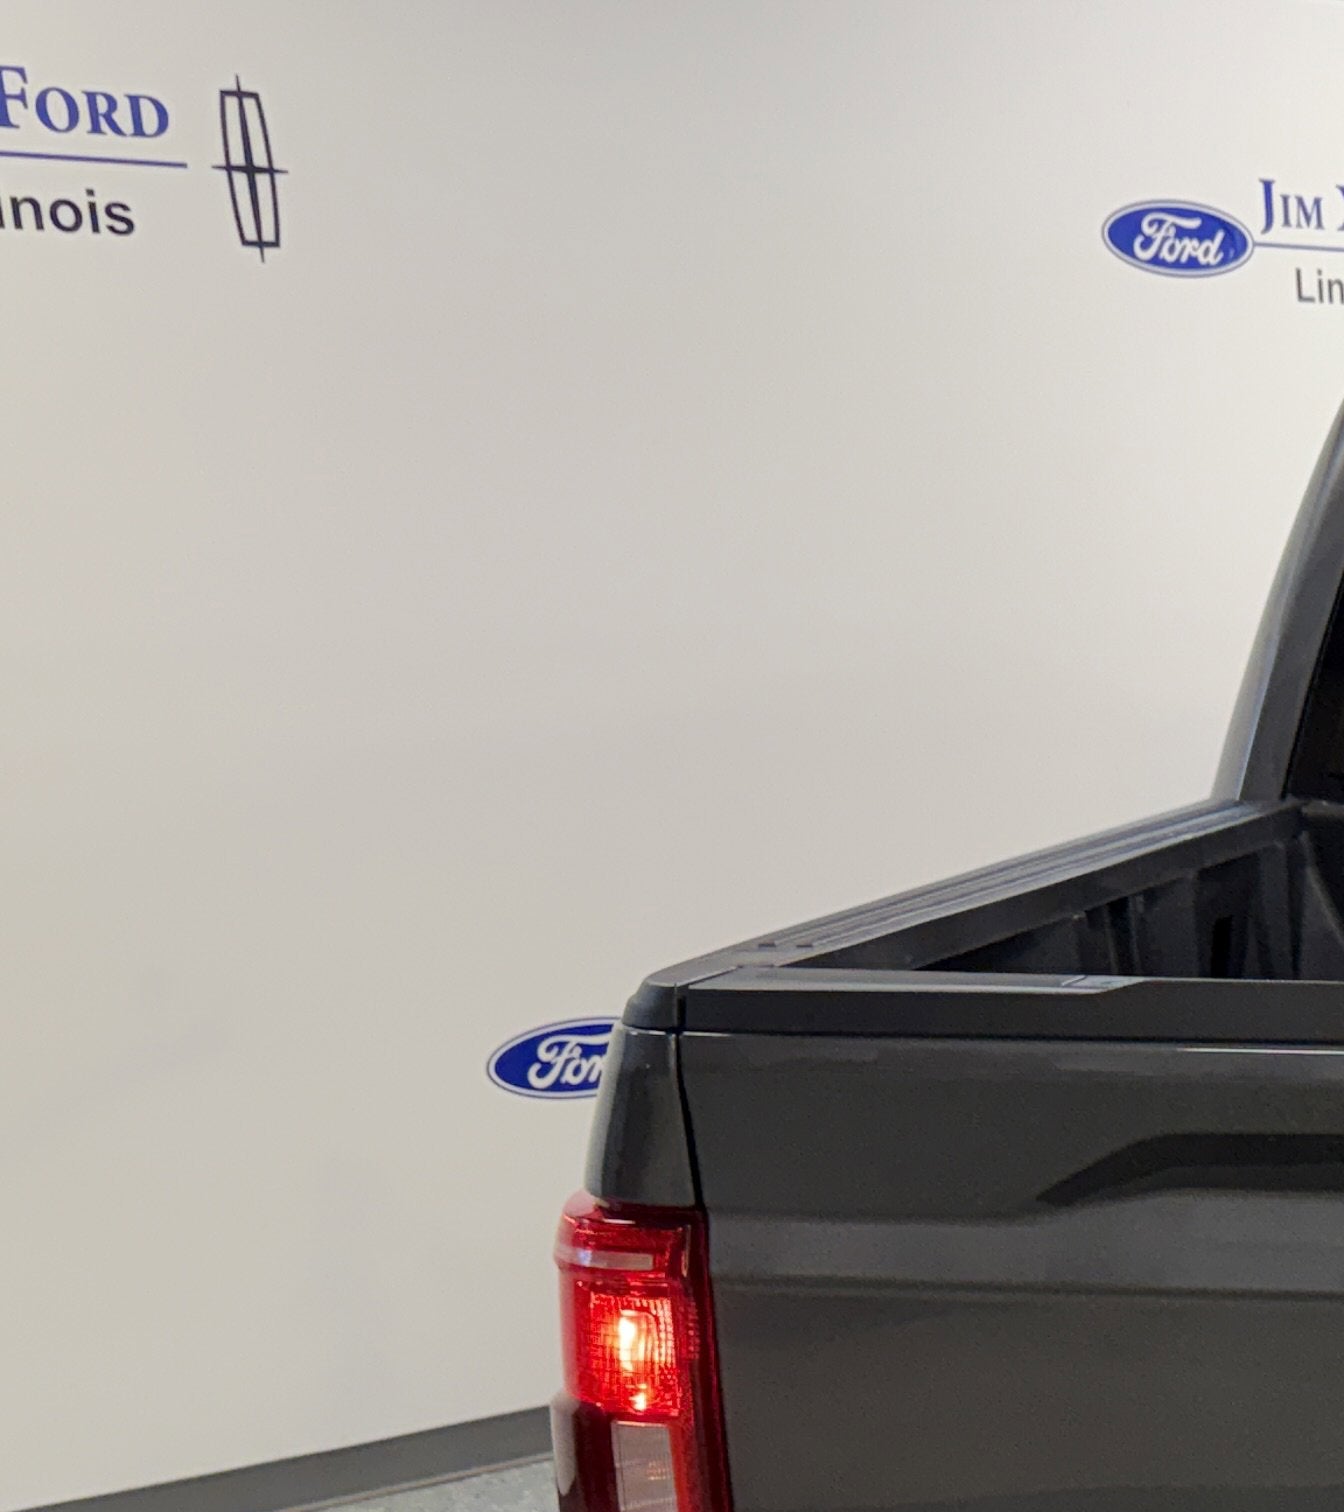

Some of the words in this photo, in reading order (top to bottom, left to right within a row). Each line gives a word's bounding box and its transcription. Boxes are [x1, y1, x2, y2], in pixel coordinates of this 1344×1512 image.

[1259, 178, 1324, 236] JIM
[1132, 212, 1224, 268] Ford
[527, 1034, 610, 1089] For
